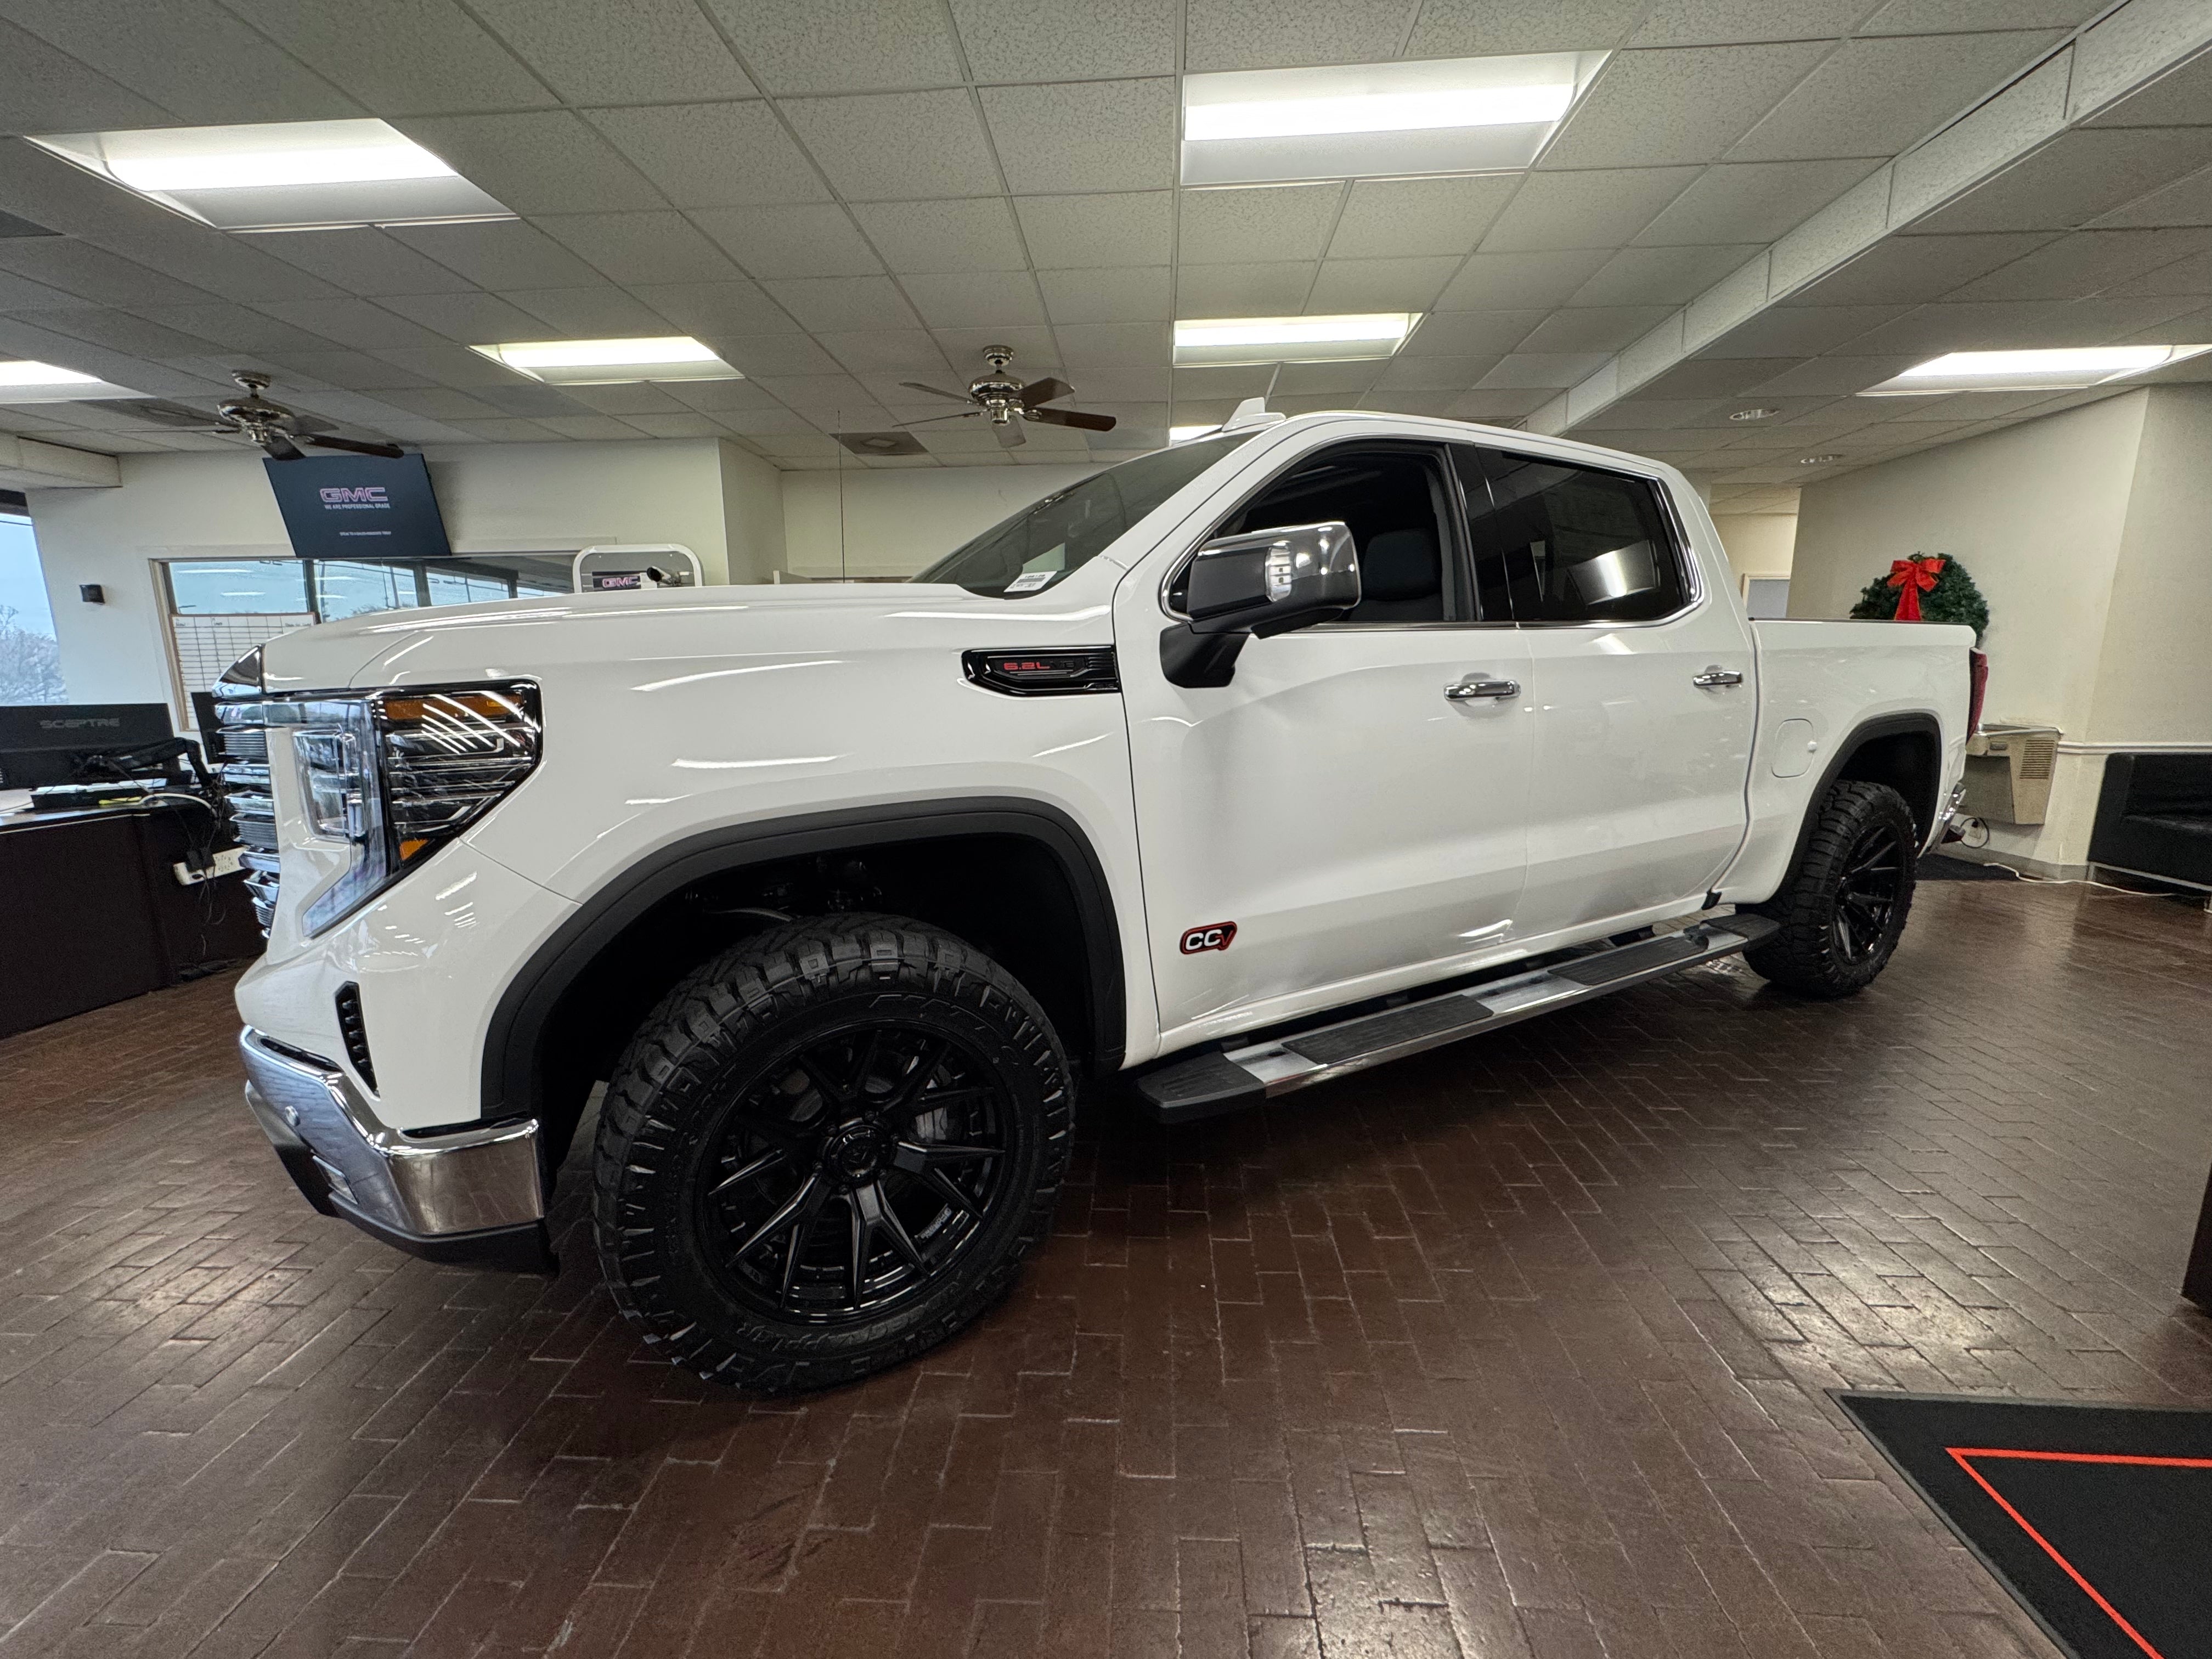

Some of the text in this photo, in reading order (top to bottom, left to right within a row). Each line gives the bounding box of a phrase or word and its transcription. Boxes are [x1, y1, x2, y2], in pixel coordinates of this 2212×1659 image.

[320, 487, 388, 503] GMC
[602, 576, 638, 588] GMC
[1003, 662, 1051, 670] 6.2L
[40, 718, 120, 729] SCEPTRE
